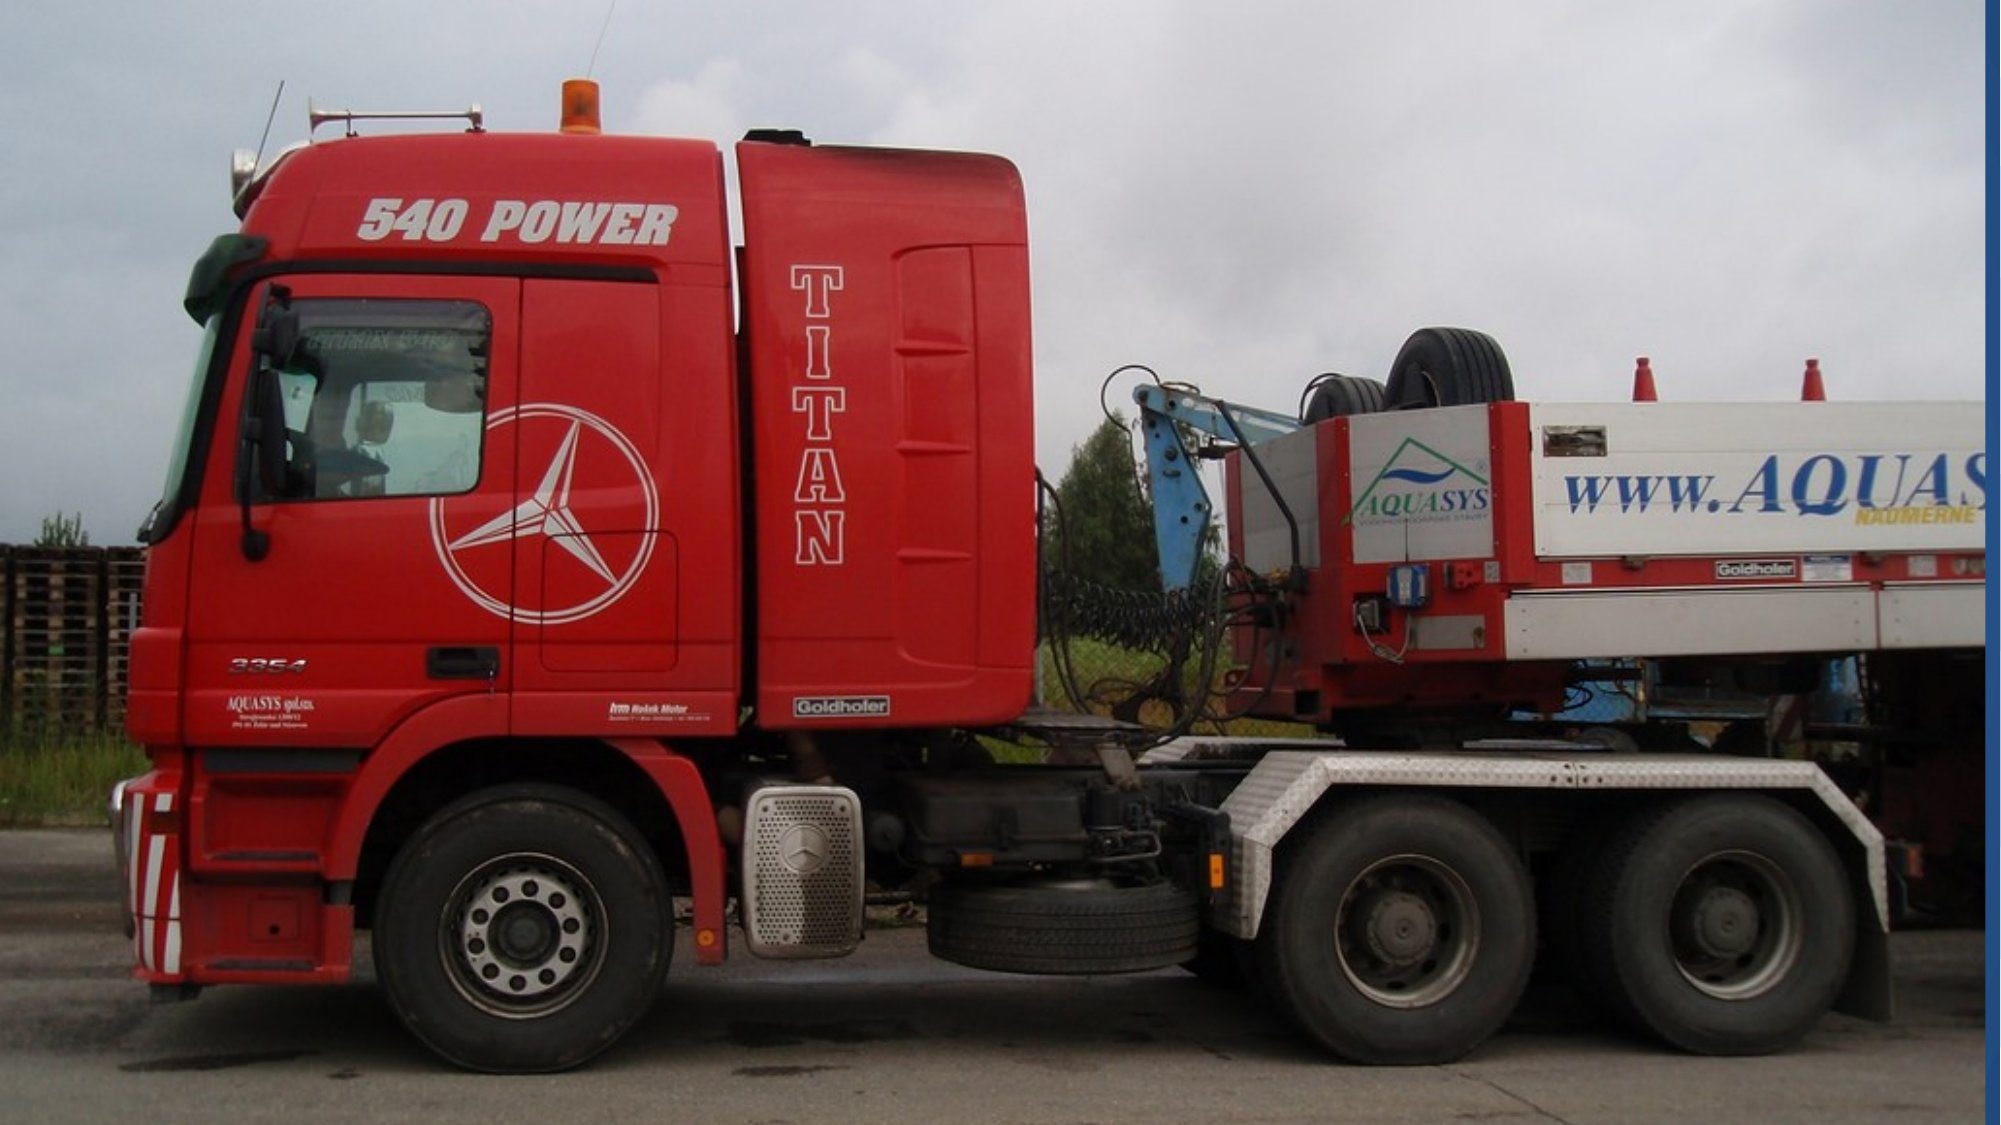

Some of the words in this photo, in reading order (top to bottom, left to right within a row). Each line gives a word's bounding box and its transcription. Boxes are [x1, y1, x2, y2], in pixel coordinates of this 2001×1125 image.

[357, 198, 469, 241] 540
[480, 200, 679, 246] POWER
[790, 264, 846, 565] TITAN
[1360, 488, 1489, 517] AQUASYS
[1718, 563, 1793, 576] Goldhofer
[227, 657, 307, 674] 3354
[226, 695, 281, 713] AQUASYS
[797, 699, 887, 714] Goldhofer
